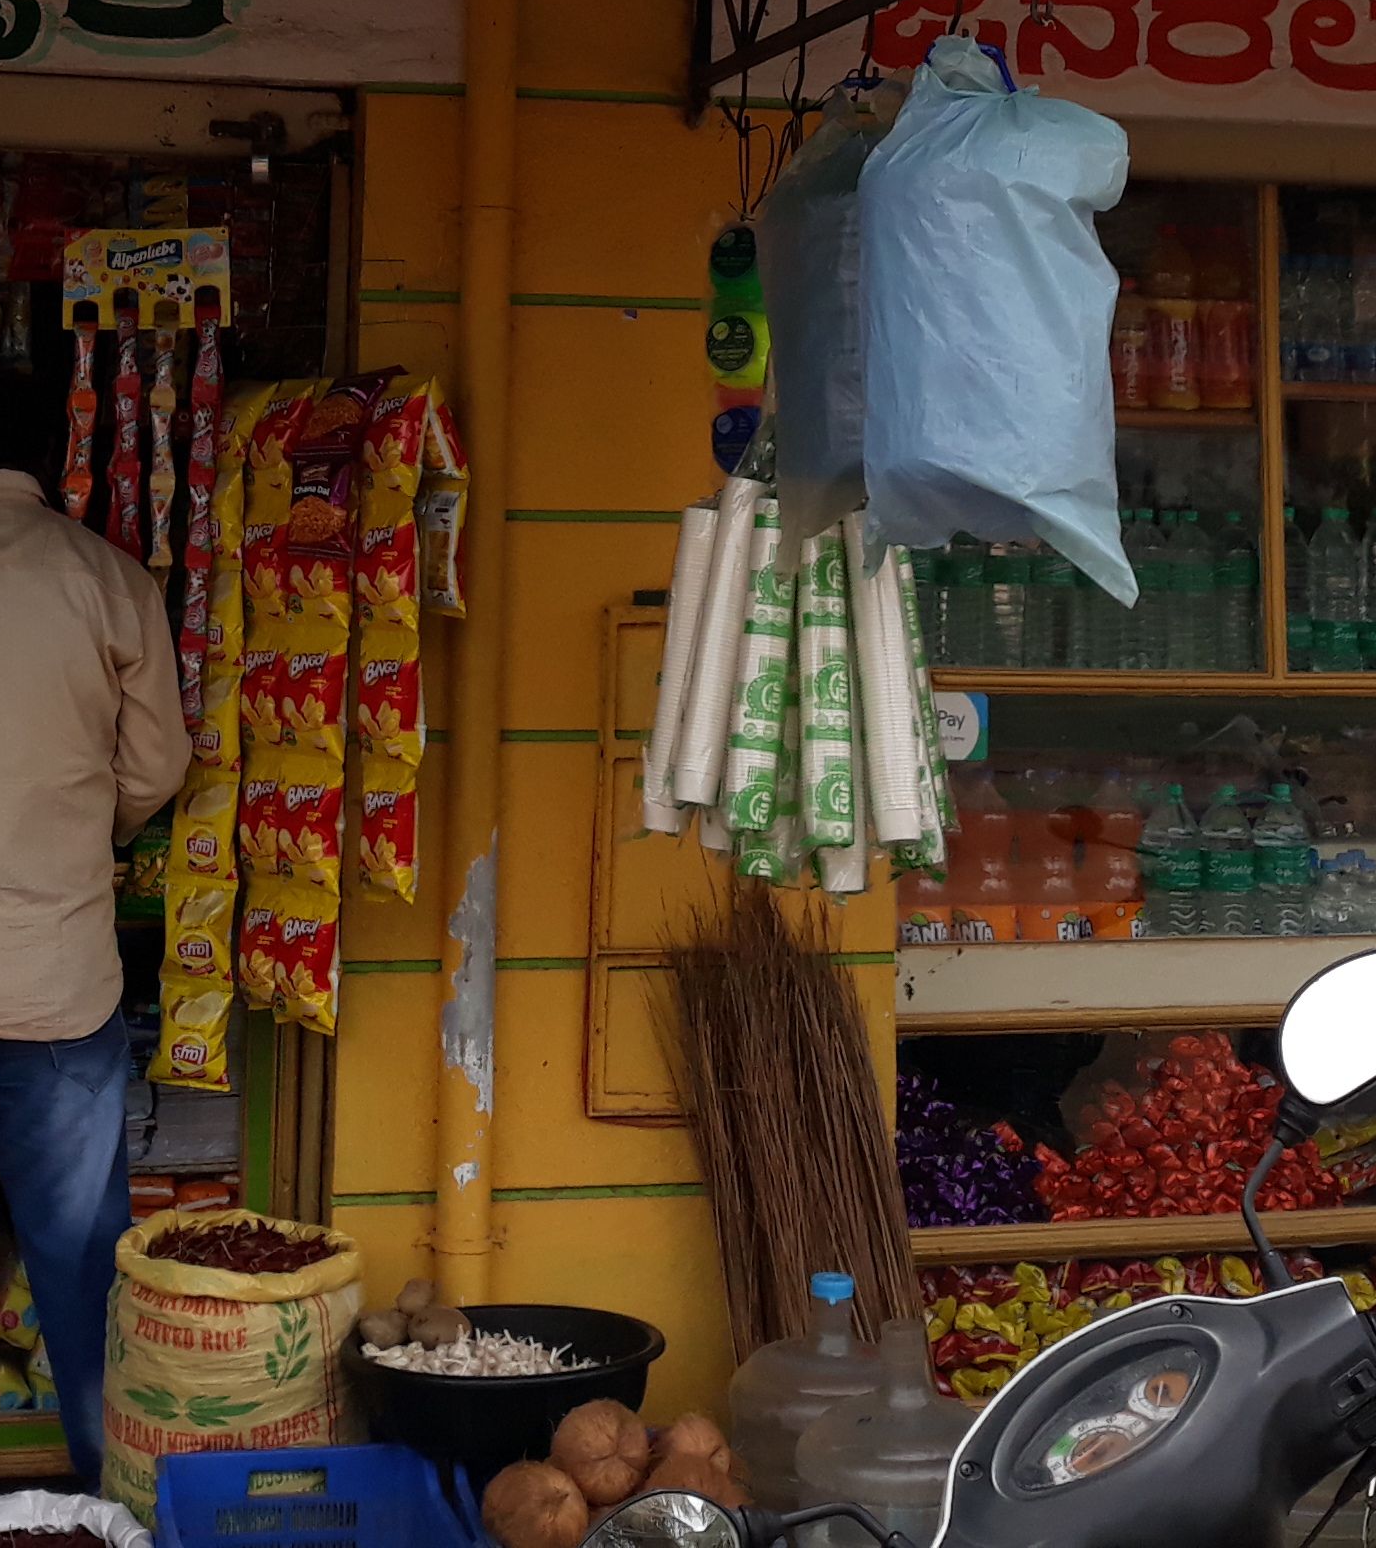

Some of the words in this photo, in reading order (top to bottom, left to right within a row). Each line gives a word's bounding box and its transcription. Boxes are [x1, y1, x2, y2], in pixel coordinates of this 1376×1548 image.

[111, 241, 178, 269] Alpenliebe
[938, 709, 966, 730] Pay
[951, 919, 993, 941] ANTA
[135, 1314, 195, 1351] PUFFED
[201, 1327, 247, 1352] RICE
[249, 1409, 321, 1449] TRADERS
